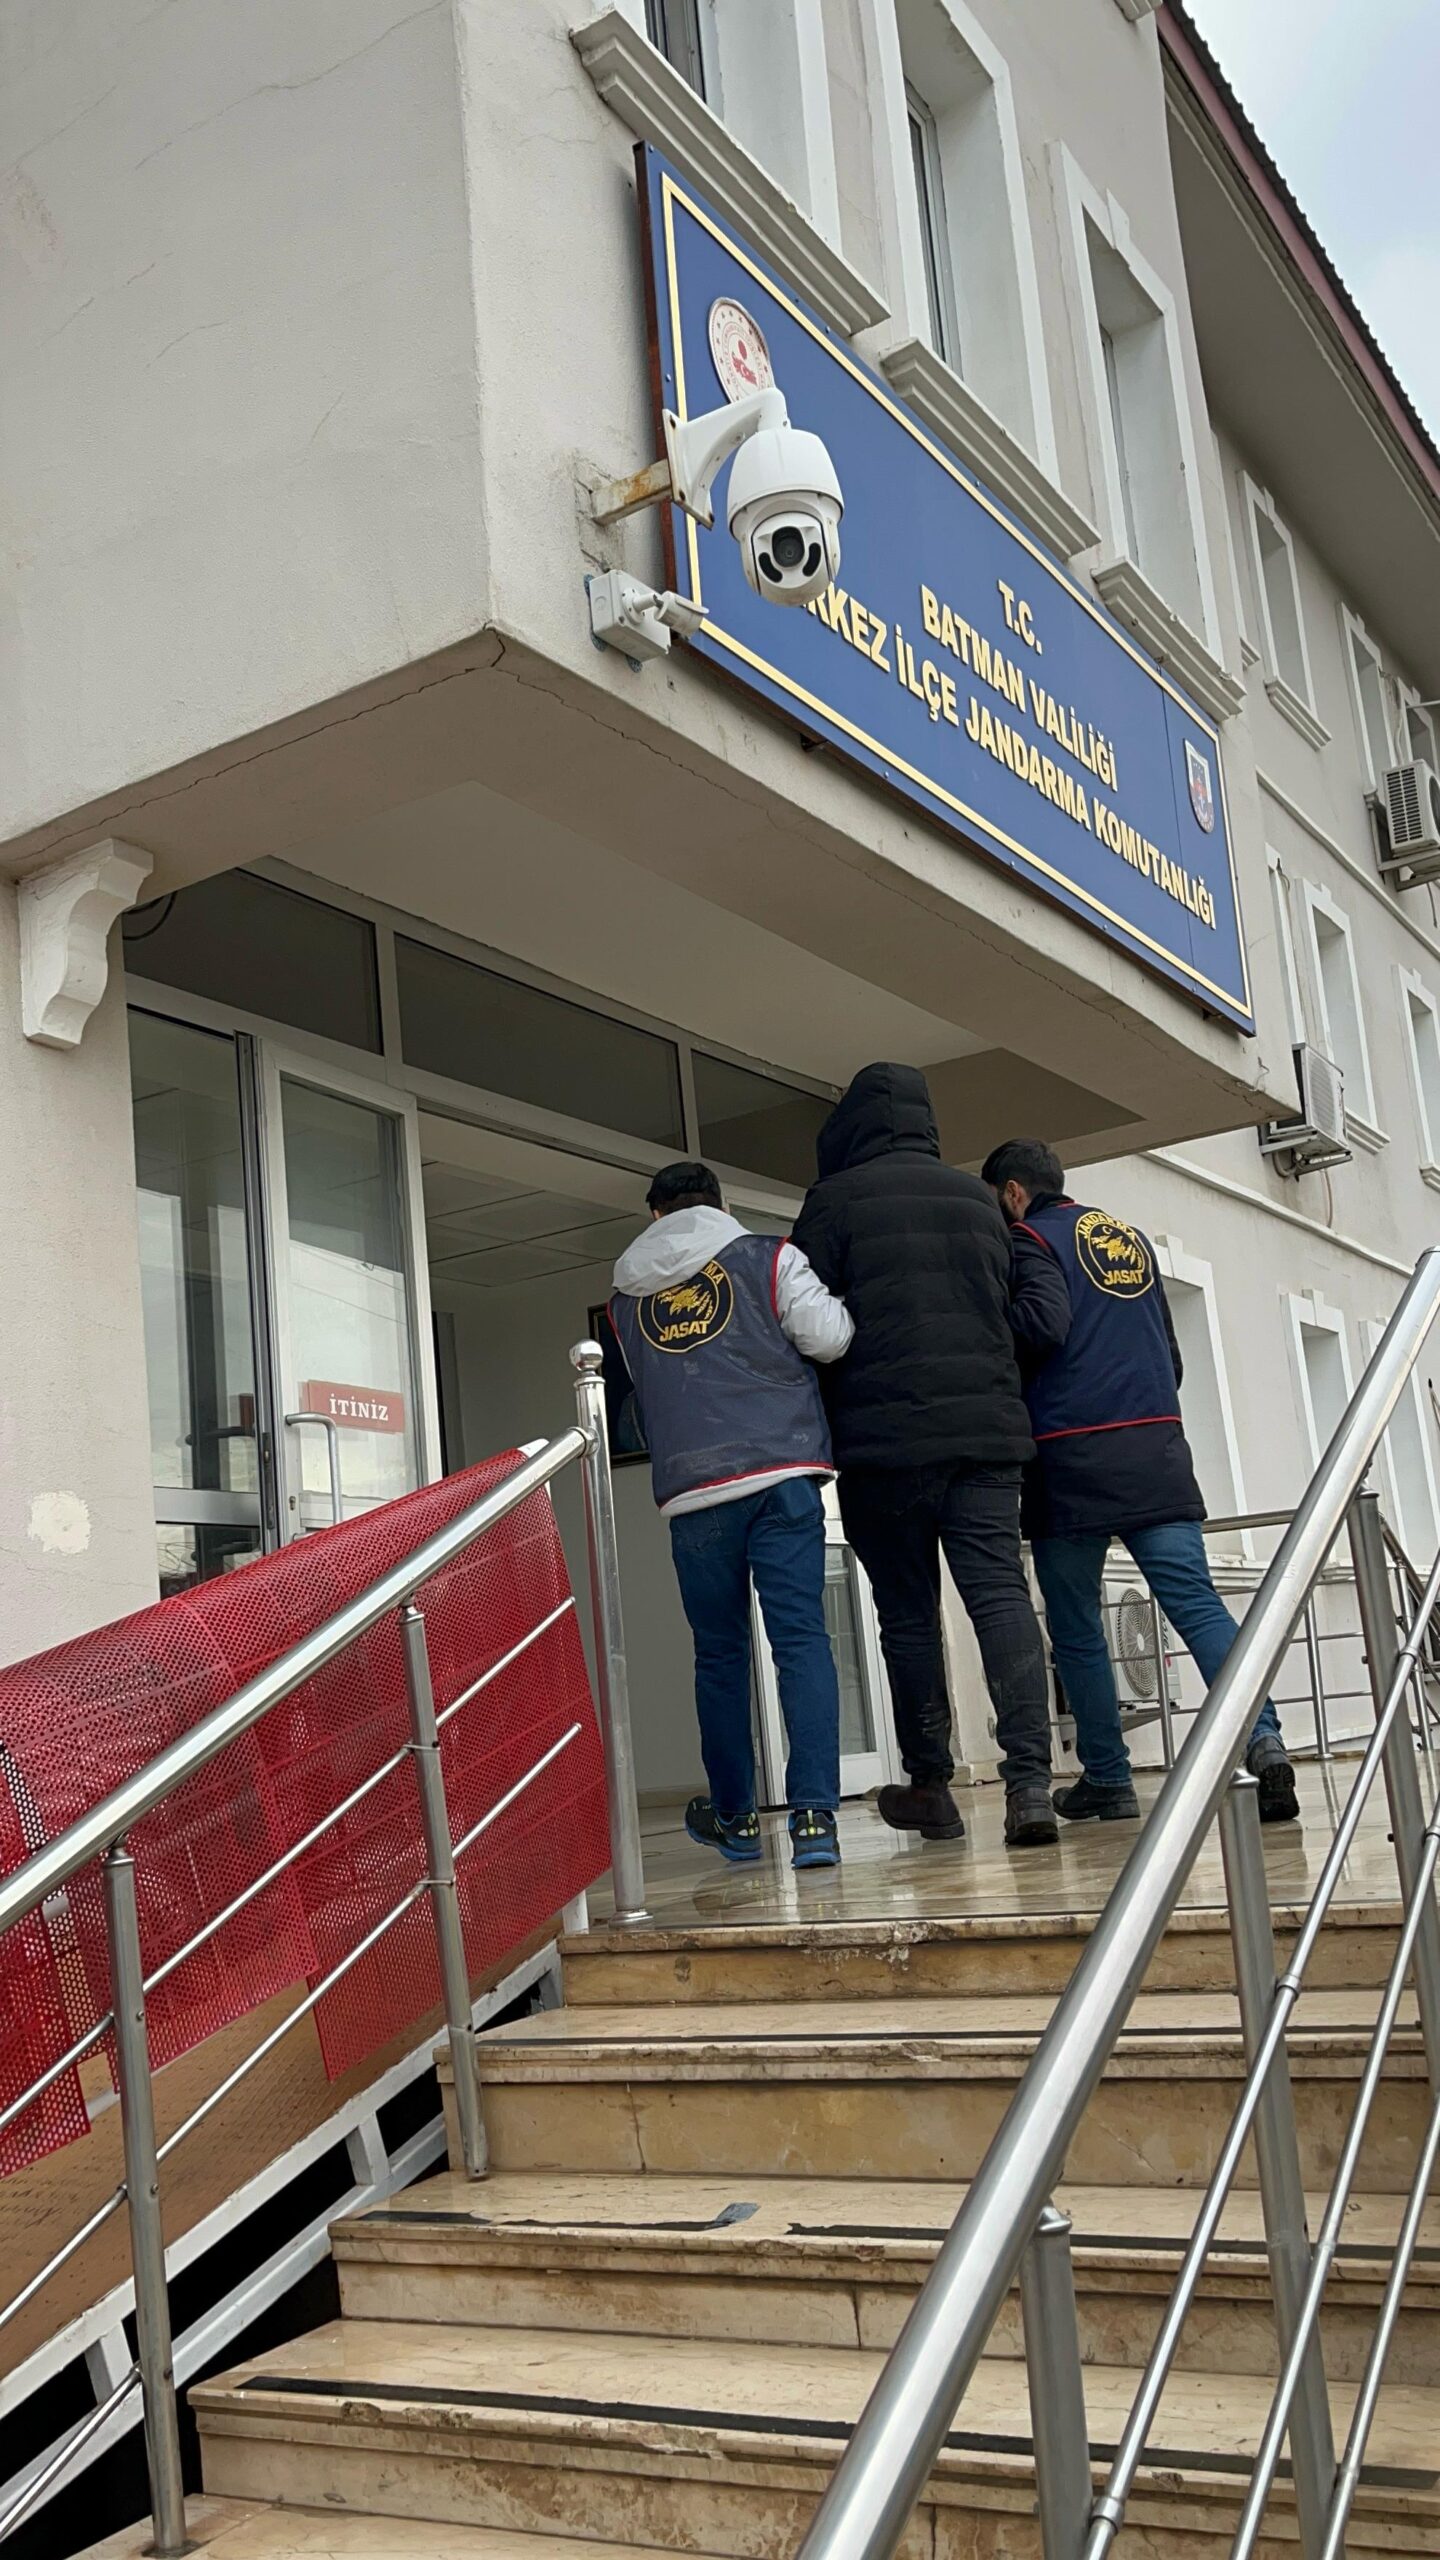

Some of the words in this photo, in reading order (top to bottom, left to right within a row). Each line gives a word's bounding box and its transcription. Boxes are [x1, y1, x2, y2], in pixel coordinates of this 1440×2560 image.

[999, 579, 1043, 655] T.C.
[921, 584, 1026, 713] BATMAN
[1029, 679, 1118, 792] VALİLİĞİ
[896, 624, 959, 727] İLÇE
[965, 696, 1091, 831] JANDARMA
[1094, 797, 1217, 930] KOMUTANLIĞI
[1104, 1269, 1144, 1285] JASAT
[659, 1320, 710, 1342] JASAT
[329, 1393, 389, 1421] İTİNİZ
